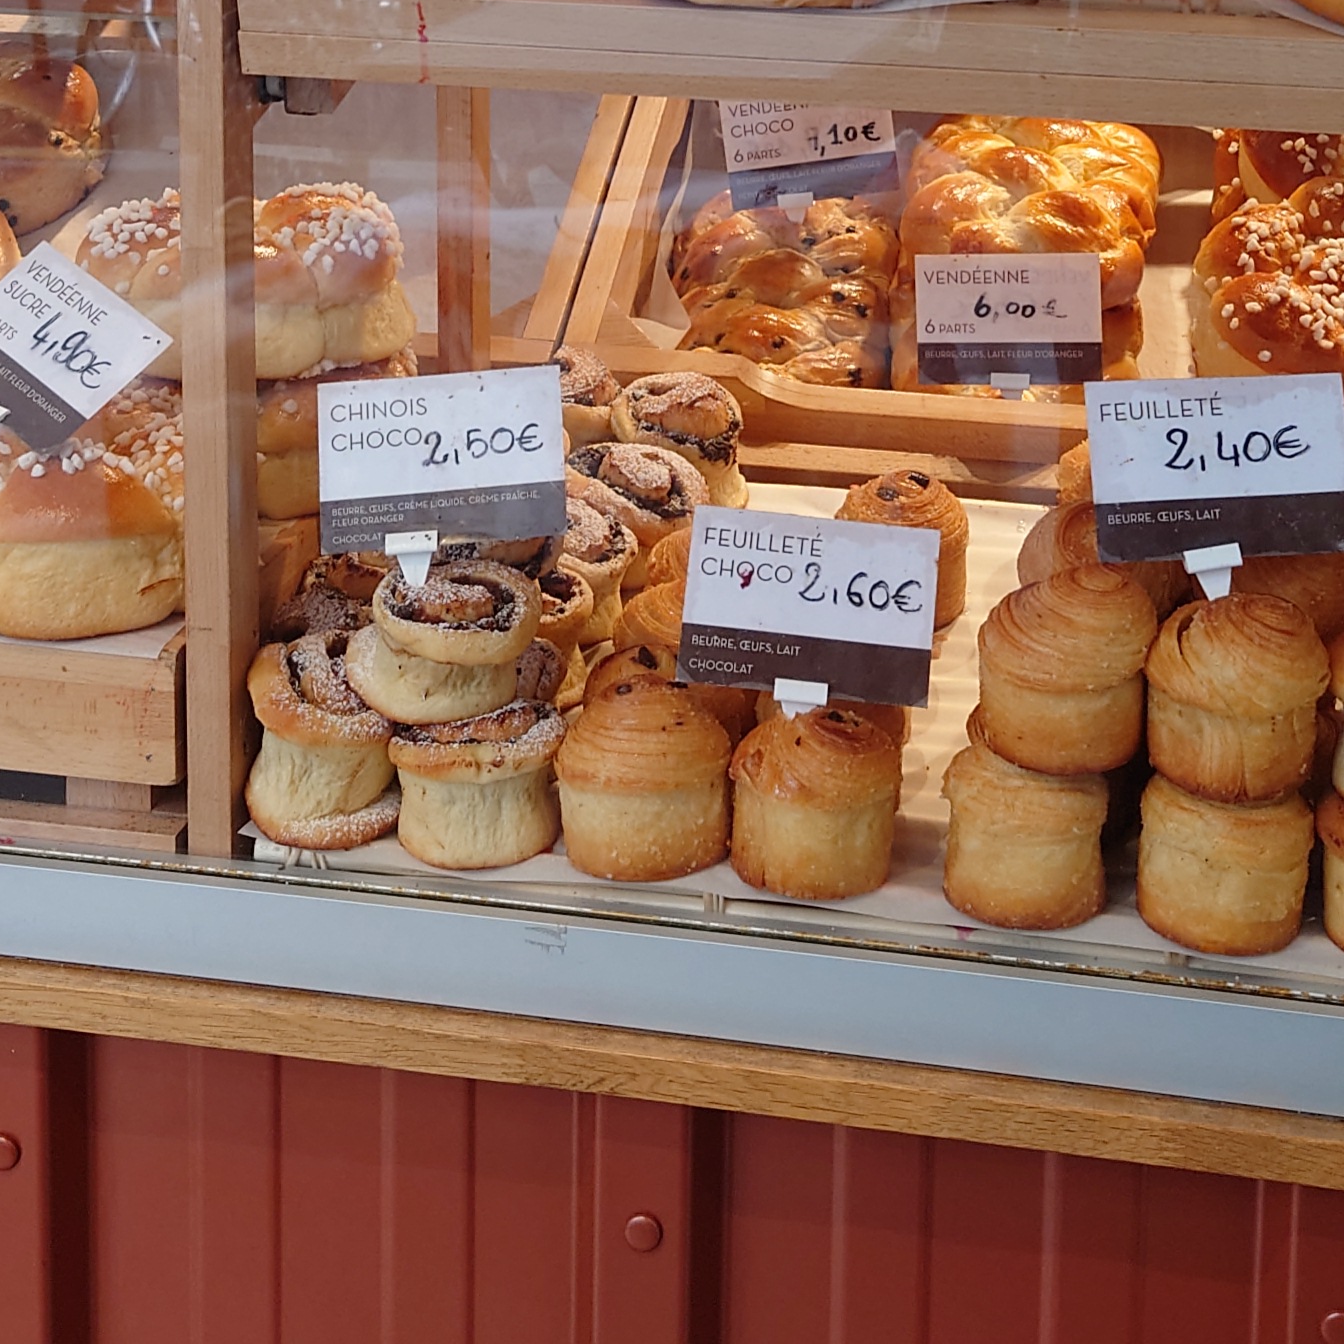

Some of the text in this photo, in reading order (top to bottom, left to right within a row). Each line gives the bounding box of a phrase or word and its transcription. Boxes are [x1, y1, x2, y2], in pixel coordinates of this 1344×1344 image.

[730, 118, 794, 139] CHOCO
[734, 148, 782, 163] 6 PARTS
[923, 265, 1030, 285] VENDÉENNE
[3, 280, 51, 320] SUCRE
[27, 260, 108, 327] VENDÉENNE
[925, 318, 976, 334] 6 PARTS
[330, 397, 428, 422] CHINOIS
[1099, 391, 1224, 422] FEUILLETÉ
[331, 423, 543, 467] CHOCO 2,50€
[1164, 425, 1312, 472] 2,40€
[332, 532, 383, 545] CHOCOLAT
[704, 527, 824, 558] FEUILLETÉ
[701, 557, 924, 613] CHOCO 2,60€
[691, 634, 737, 650] BEURRE,
[776, 643, 801, 657] LAIT
[688, 658, 754, 674] CHOCOLAT
